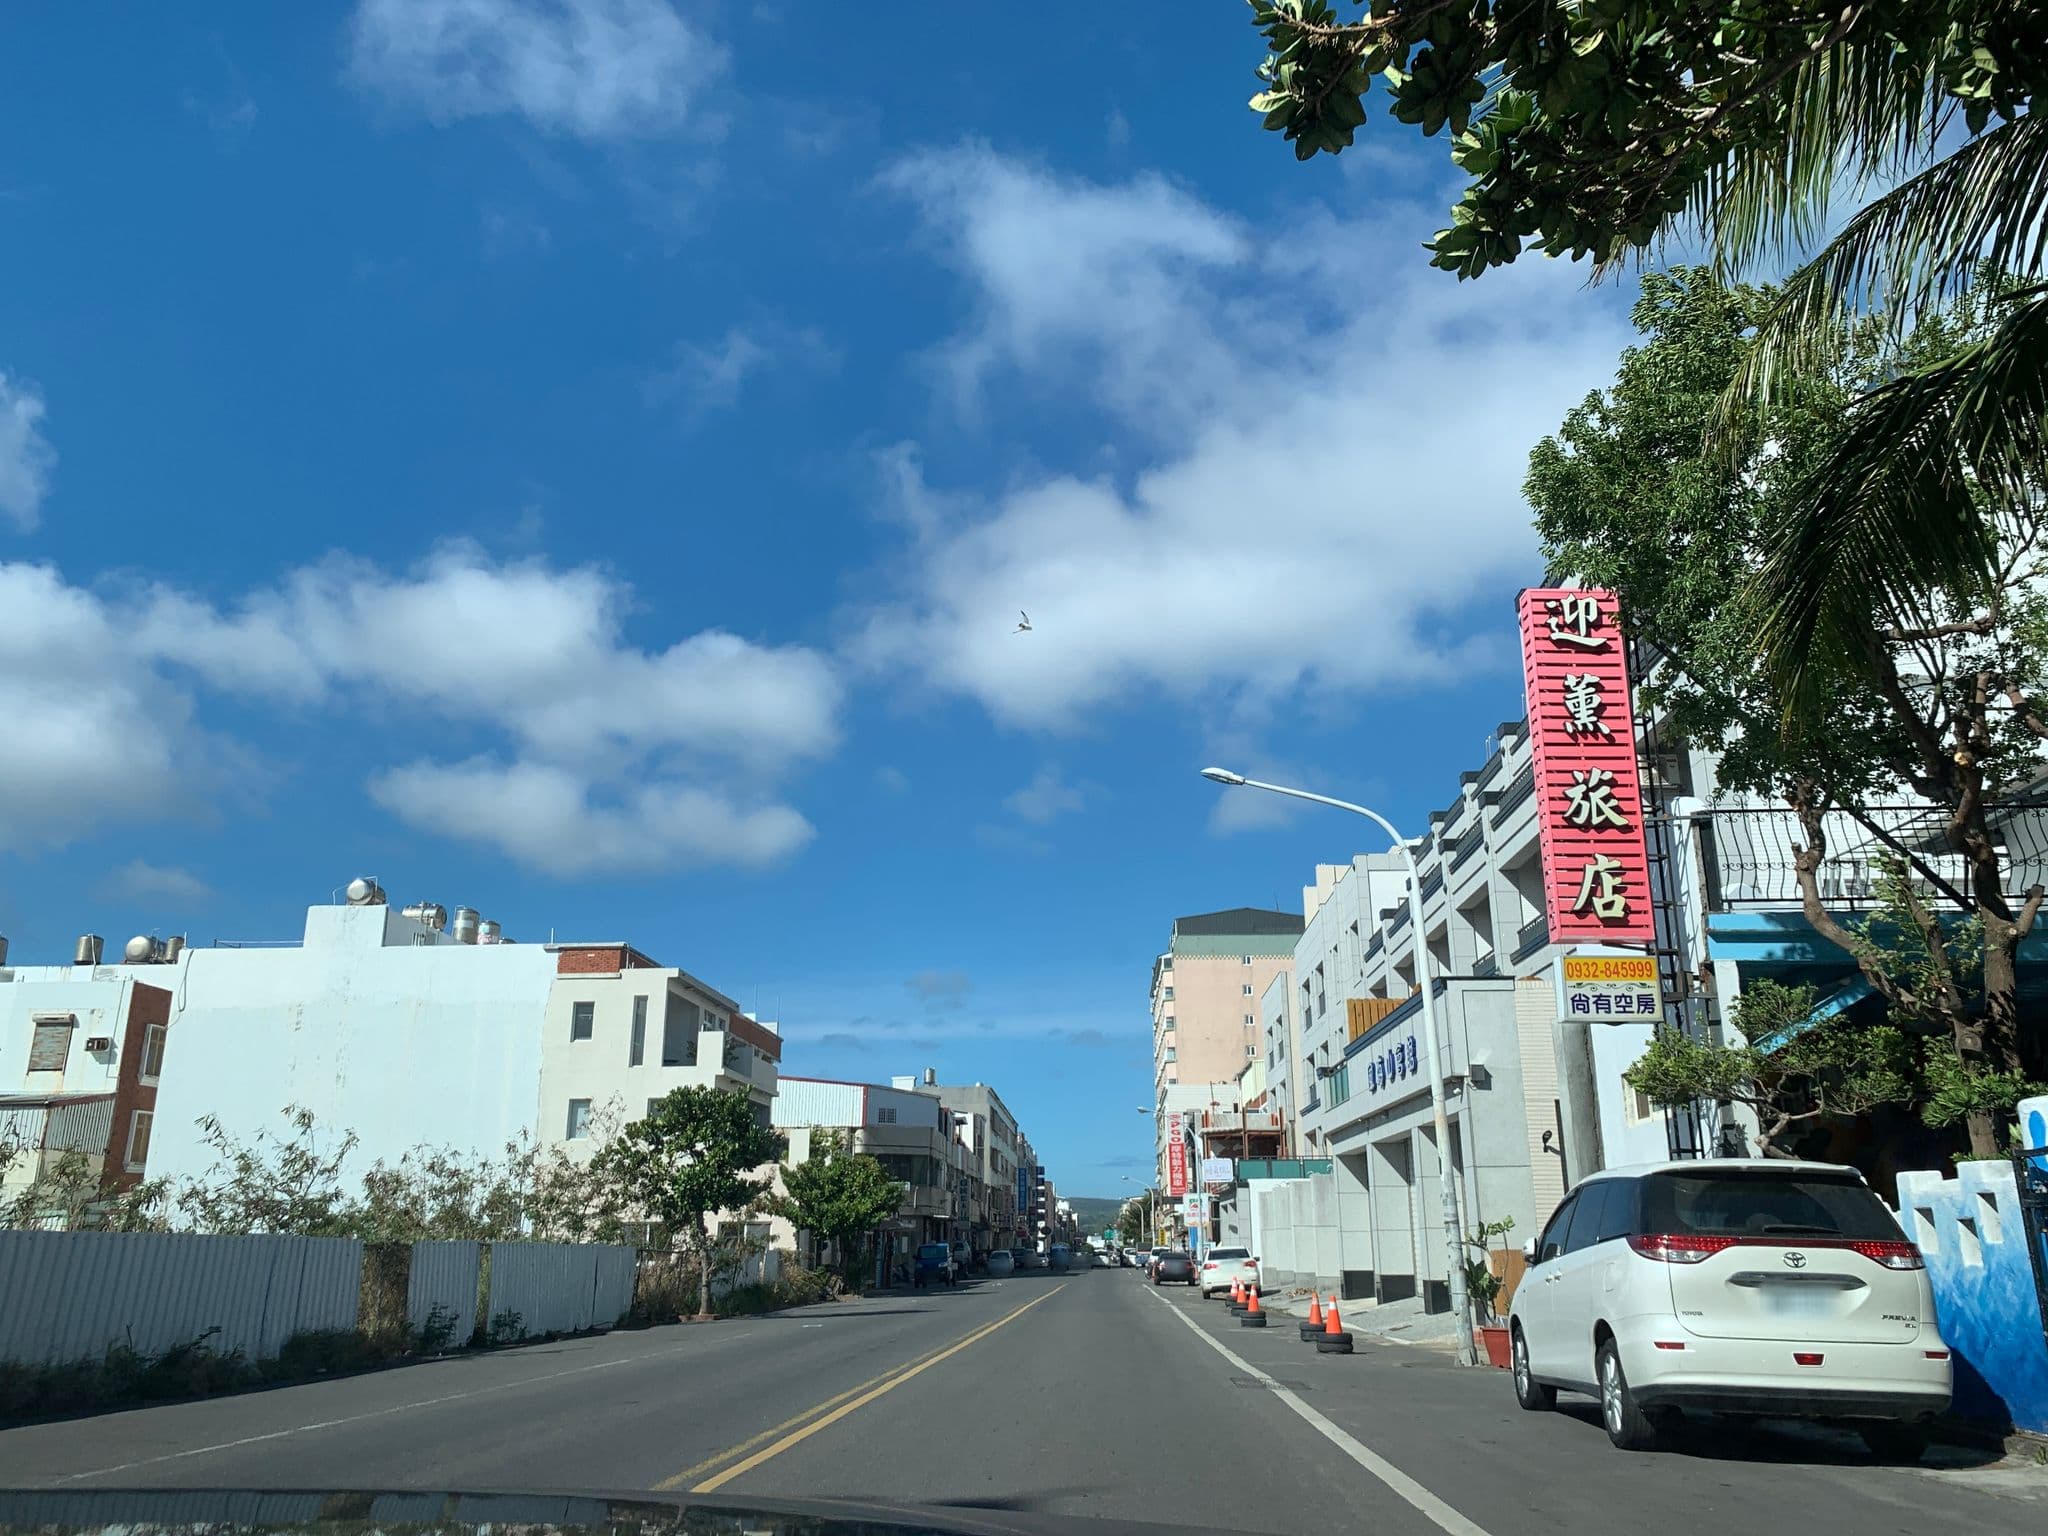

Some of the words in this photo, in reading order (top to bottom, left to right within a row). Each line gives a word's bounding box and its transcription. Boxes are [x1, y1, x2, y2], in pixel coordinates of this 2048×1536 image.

[1546, 593, 1629, 918] 迎薰旅店
[1566, 961, 1653, 978] 0932-845999
[1570, 993, 1656, 1015] 尚有空房
